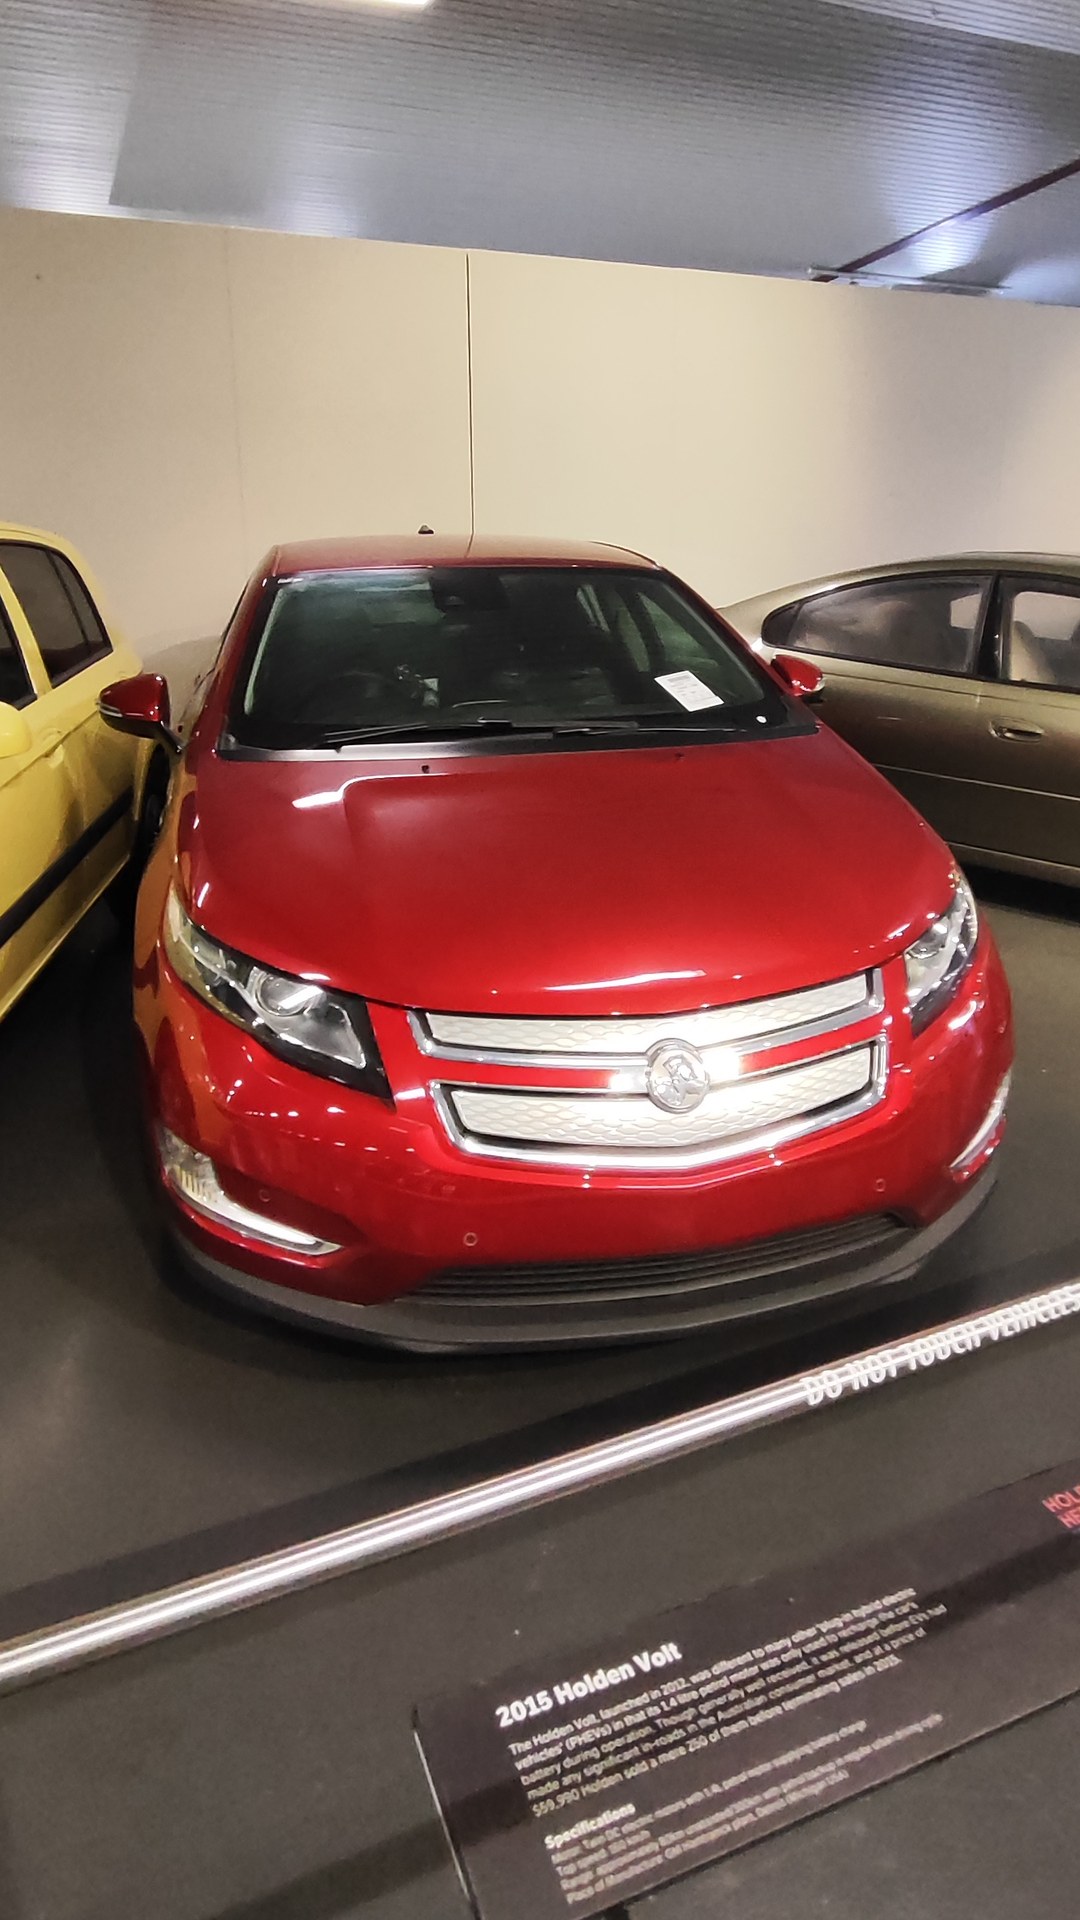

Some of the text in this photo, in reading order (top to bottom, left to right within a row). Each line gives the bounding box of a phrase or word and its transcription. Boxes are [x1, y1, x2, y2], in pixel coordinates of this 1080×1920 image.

[800, 1370, 842, 1405] DO
[847, 1350, 897, 1390] NOT
[900, 1319, 982, 1370] TOUCH
[495, 1642, 682, 1728] 2015 Holden Volt
[507, 1740, 533, 1755] The
[531, 1723, 575, 1746] Holden
[598, 1691, 650, 1720] launched
[648, 1689, 662, 1700] in
[688, 1669, 712, 1684] was
[710, 1651, 754, 1675] different
[564, 1723, 612, 1751] (PHEVs)
[610, 1720, 625, 1731] in
[622, 1709, 647, 1726] that
[698, 1675, 730, 1698] petrol
[520, 1762, 561, 1786] battery
[562, 1746, 601, 1769] during
[654, 1707, 698, 1729] Though
[697, 1688, 745, 1715] generally
[526, 1780, 560, 1800] made
[561, 1771, 582, 1786] any
[582, 1745, 641, 1777] significant
[686, 1723, 699, 1734] in
[696, 1716, 717, 1729] the
[716, 1694, 768, 1722] Australian
[580, 1772, 624, 1797] Holden
[623, 1760, 650, 1779] sold
[648, 1758, 659, 1769] a
[657, 1745, 687, 1764] mere
[708, 1728, 721, 1743] of
[719, 1719, 750, 1738] them
[544, 1803, 636, 1849] Specifications
